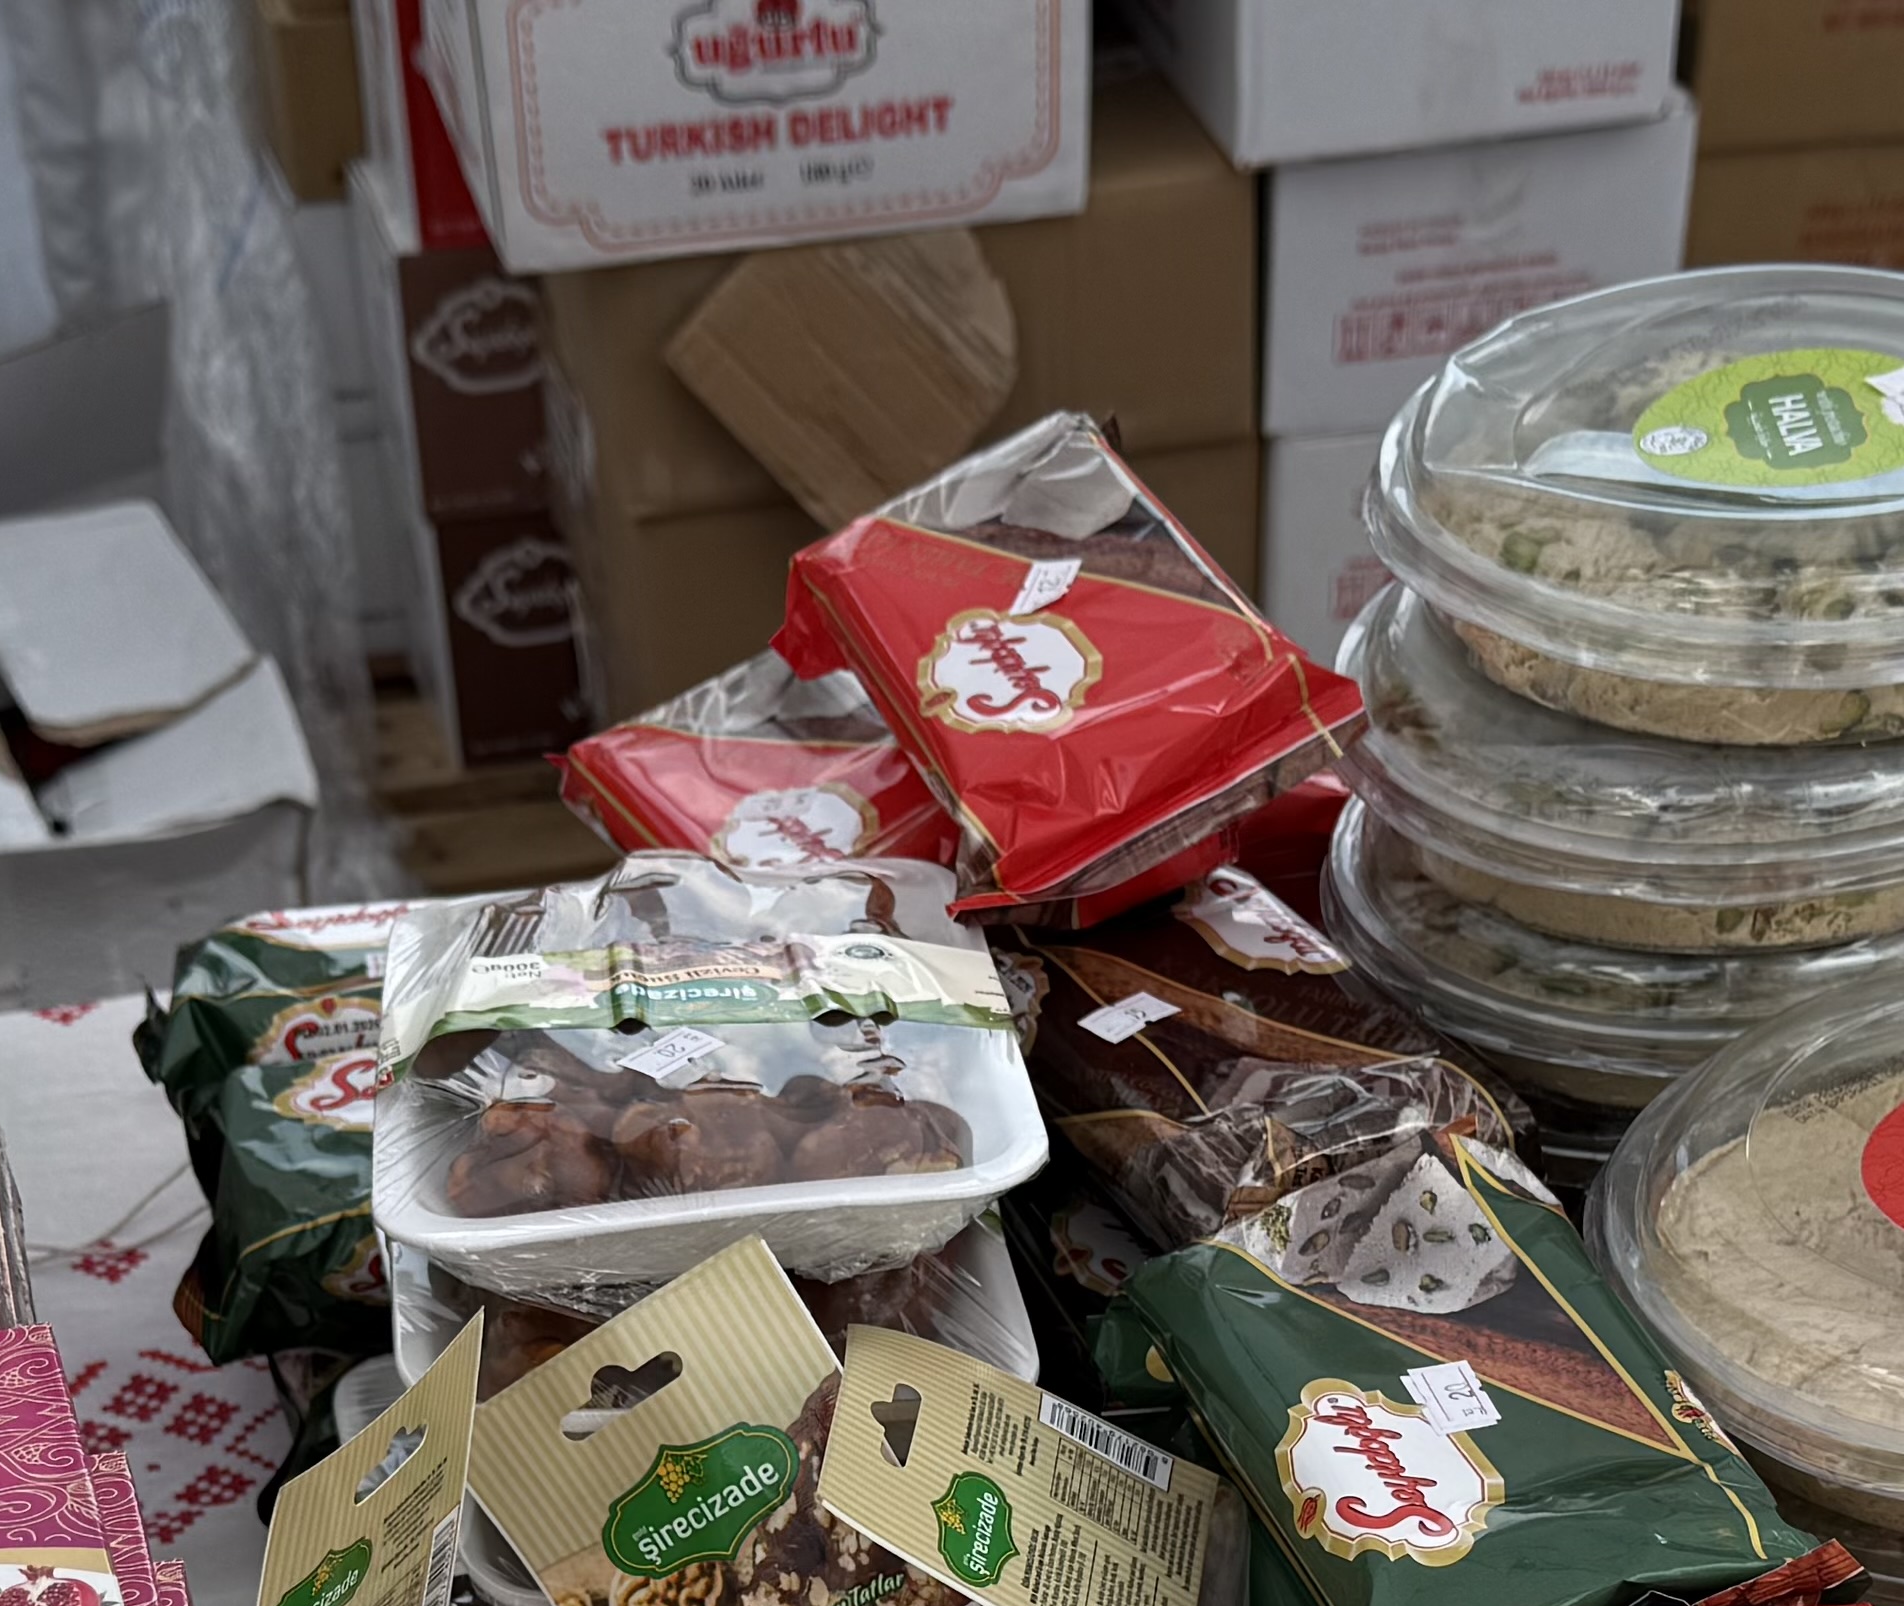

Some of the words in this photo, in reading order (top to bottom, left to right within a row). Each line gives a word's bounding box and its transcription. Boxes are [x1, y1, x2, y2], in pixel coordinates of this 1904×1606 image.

[605, 113, 777, 165] TURKISH
[788, 96, 954, 148] DELIGHT
[1769, 393, 1823, 455] HALVA
[638, 1462, 781, 1566] şirecizade
[1314, 1404, 1456, 1537] Seyidoğlu
[968, 1490, 1000, 1577] şirecizade
